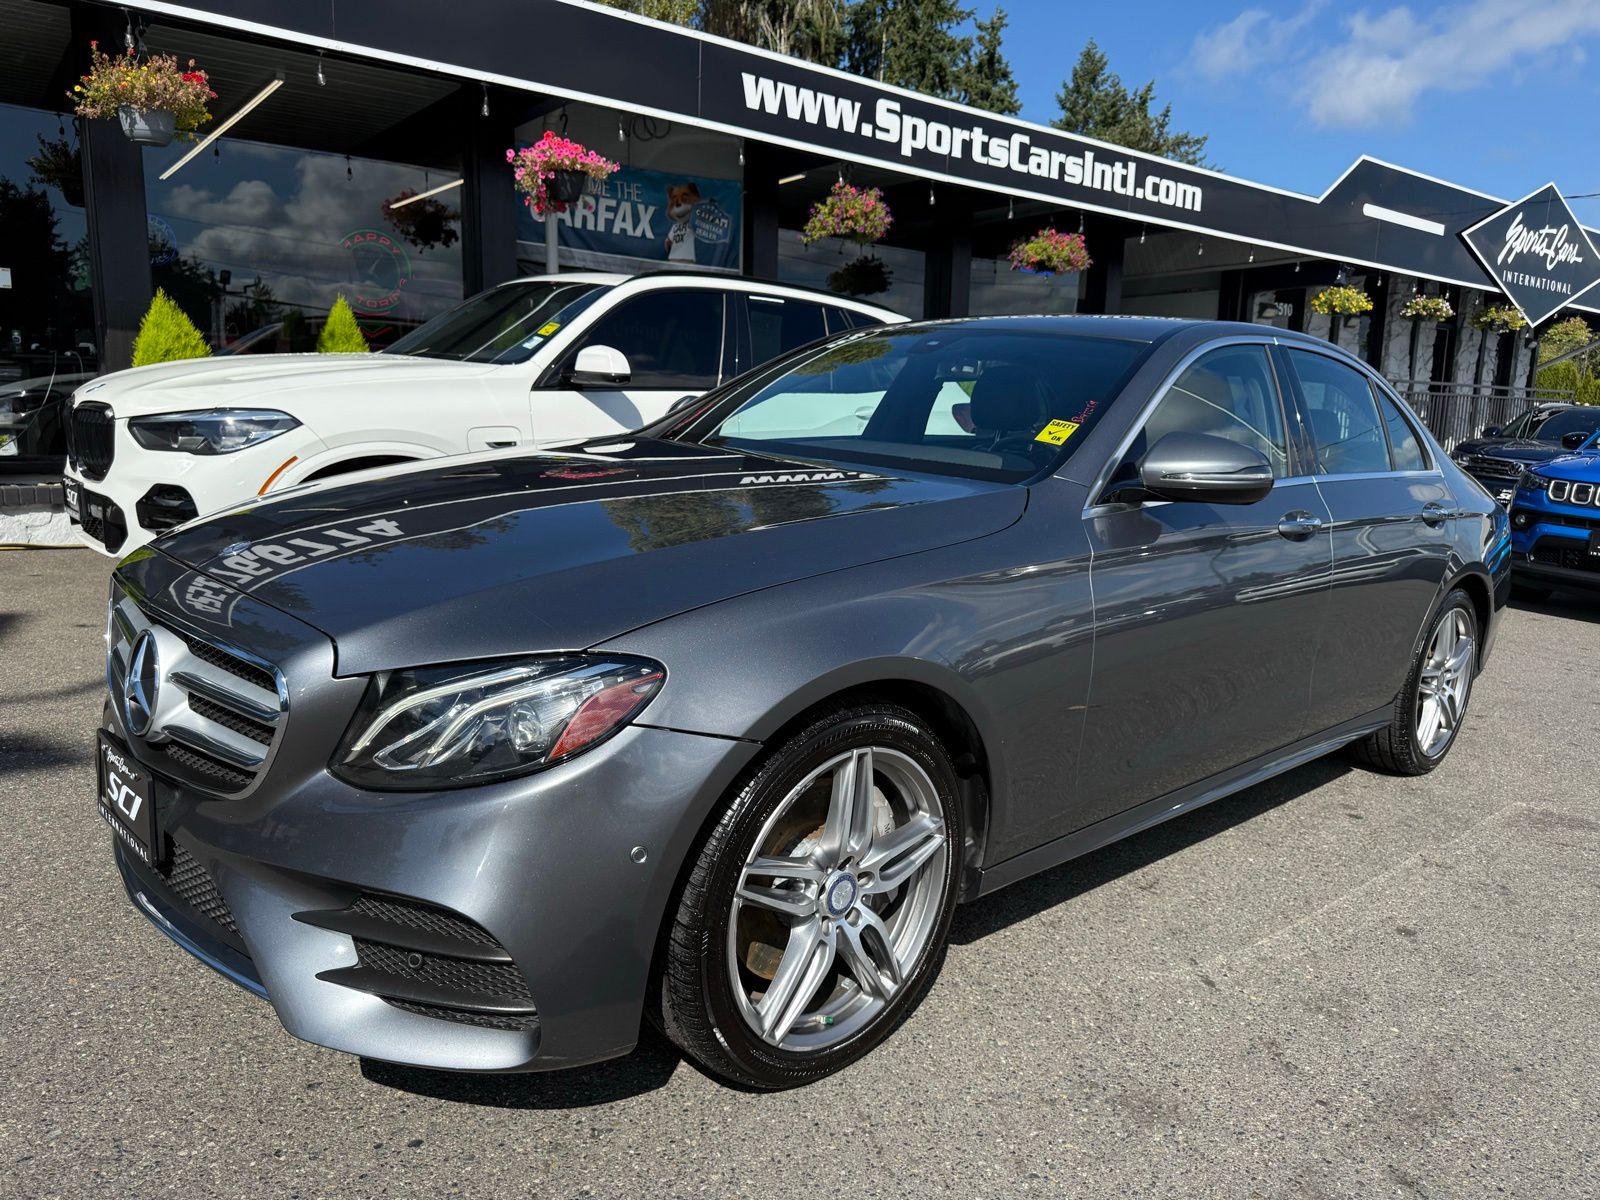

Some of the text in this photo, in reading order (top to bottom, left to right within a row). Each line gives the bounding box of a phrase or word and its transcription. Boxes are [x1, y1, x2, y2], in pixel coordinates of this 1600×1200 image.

[741, 72, 1203, 212] www.SportsCarsIntl.com
[614, 181, 643, 203] THE
[1502, 270, 1572, 295] INTERNATIONAL
[1050, 420, 1077, 430] SAFETY
[107, 771, 142, 821] SCI
